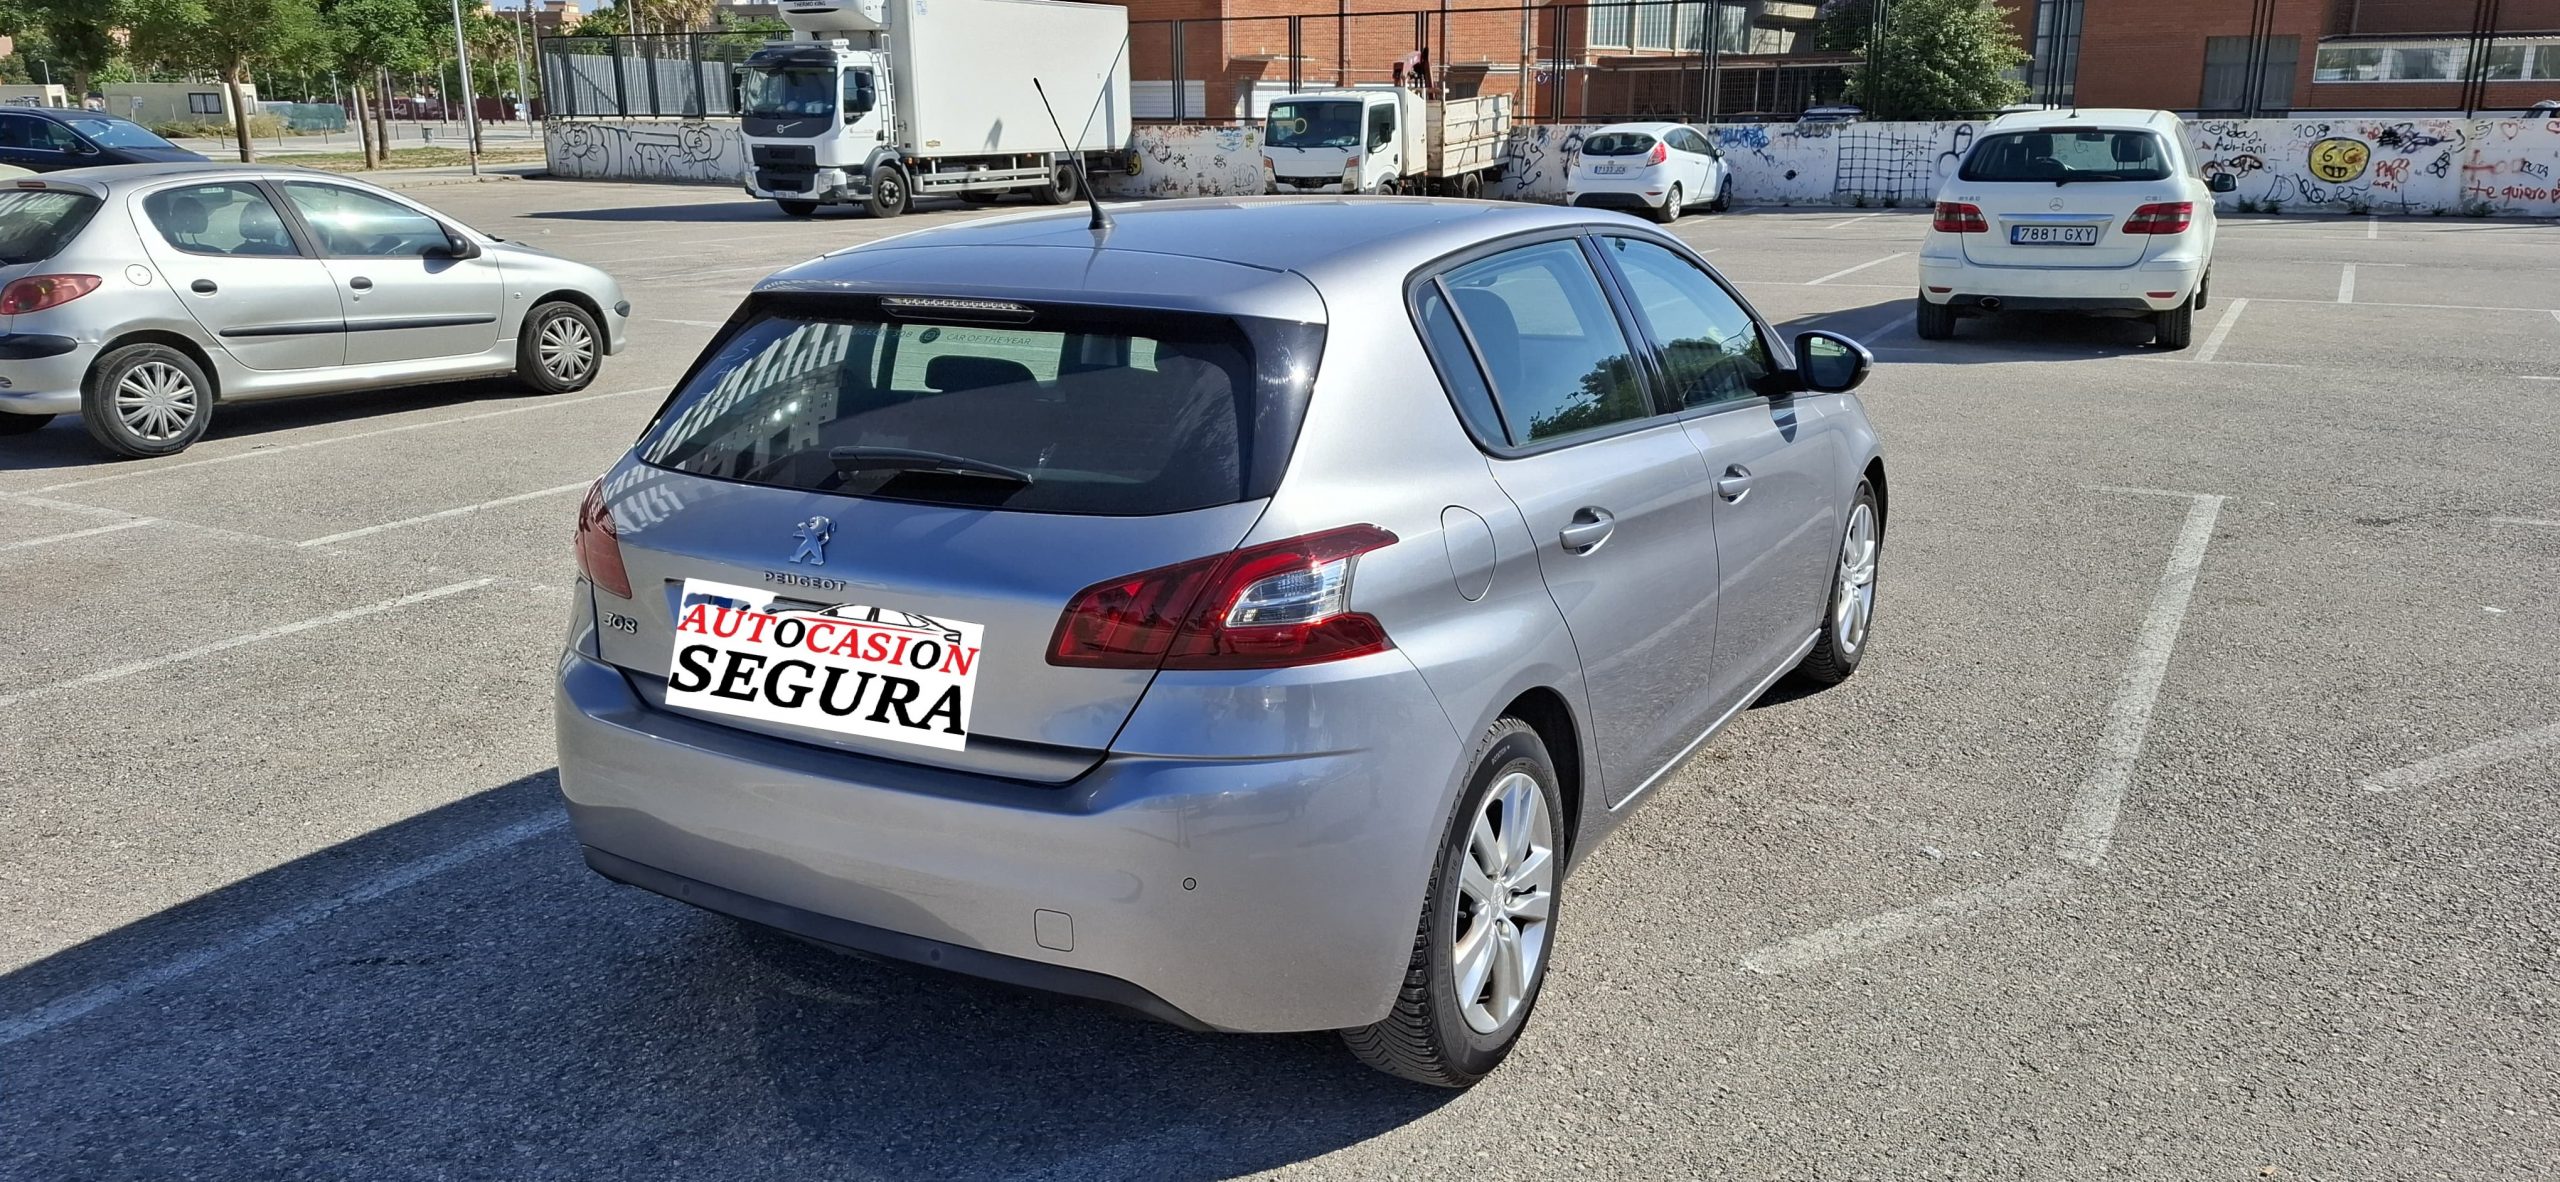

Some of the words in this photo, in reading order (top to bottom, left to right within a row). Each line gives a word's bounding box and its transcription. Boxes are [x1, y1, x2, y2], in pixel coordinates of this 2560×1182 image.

[2293, 124, 2330, 138] 108
[2469, 180, 2497, 201] te
[2502, 184, 2547, 207] quiero
[2021, 228, 2057, 241] 7881
[2064, 228, 2093, 241] GXY
[946, 333, 966, 342] CAR
[967, 334, 982, 343] OF
[984, 335, 1005, 344] THE
[1005, 337, 1032, 345] YEAR
[764, 571, 846, 591] PEUGEOT
[603, 611, 637, 633] 308
